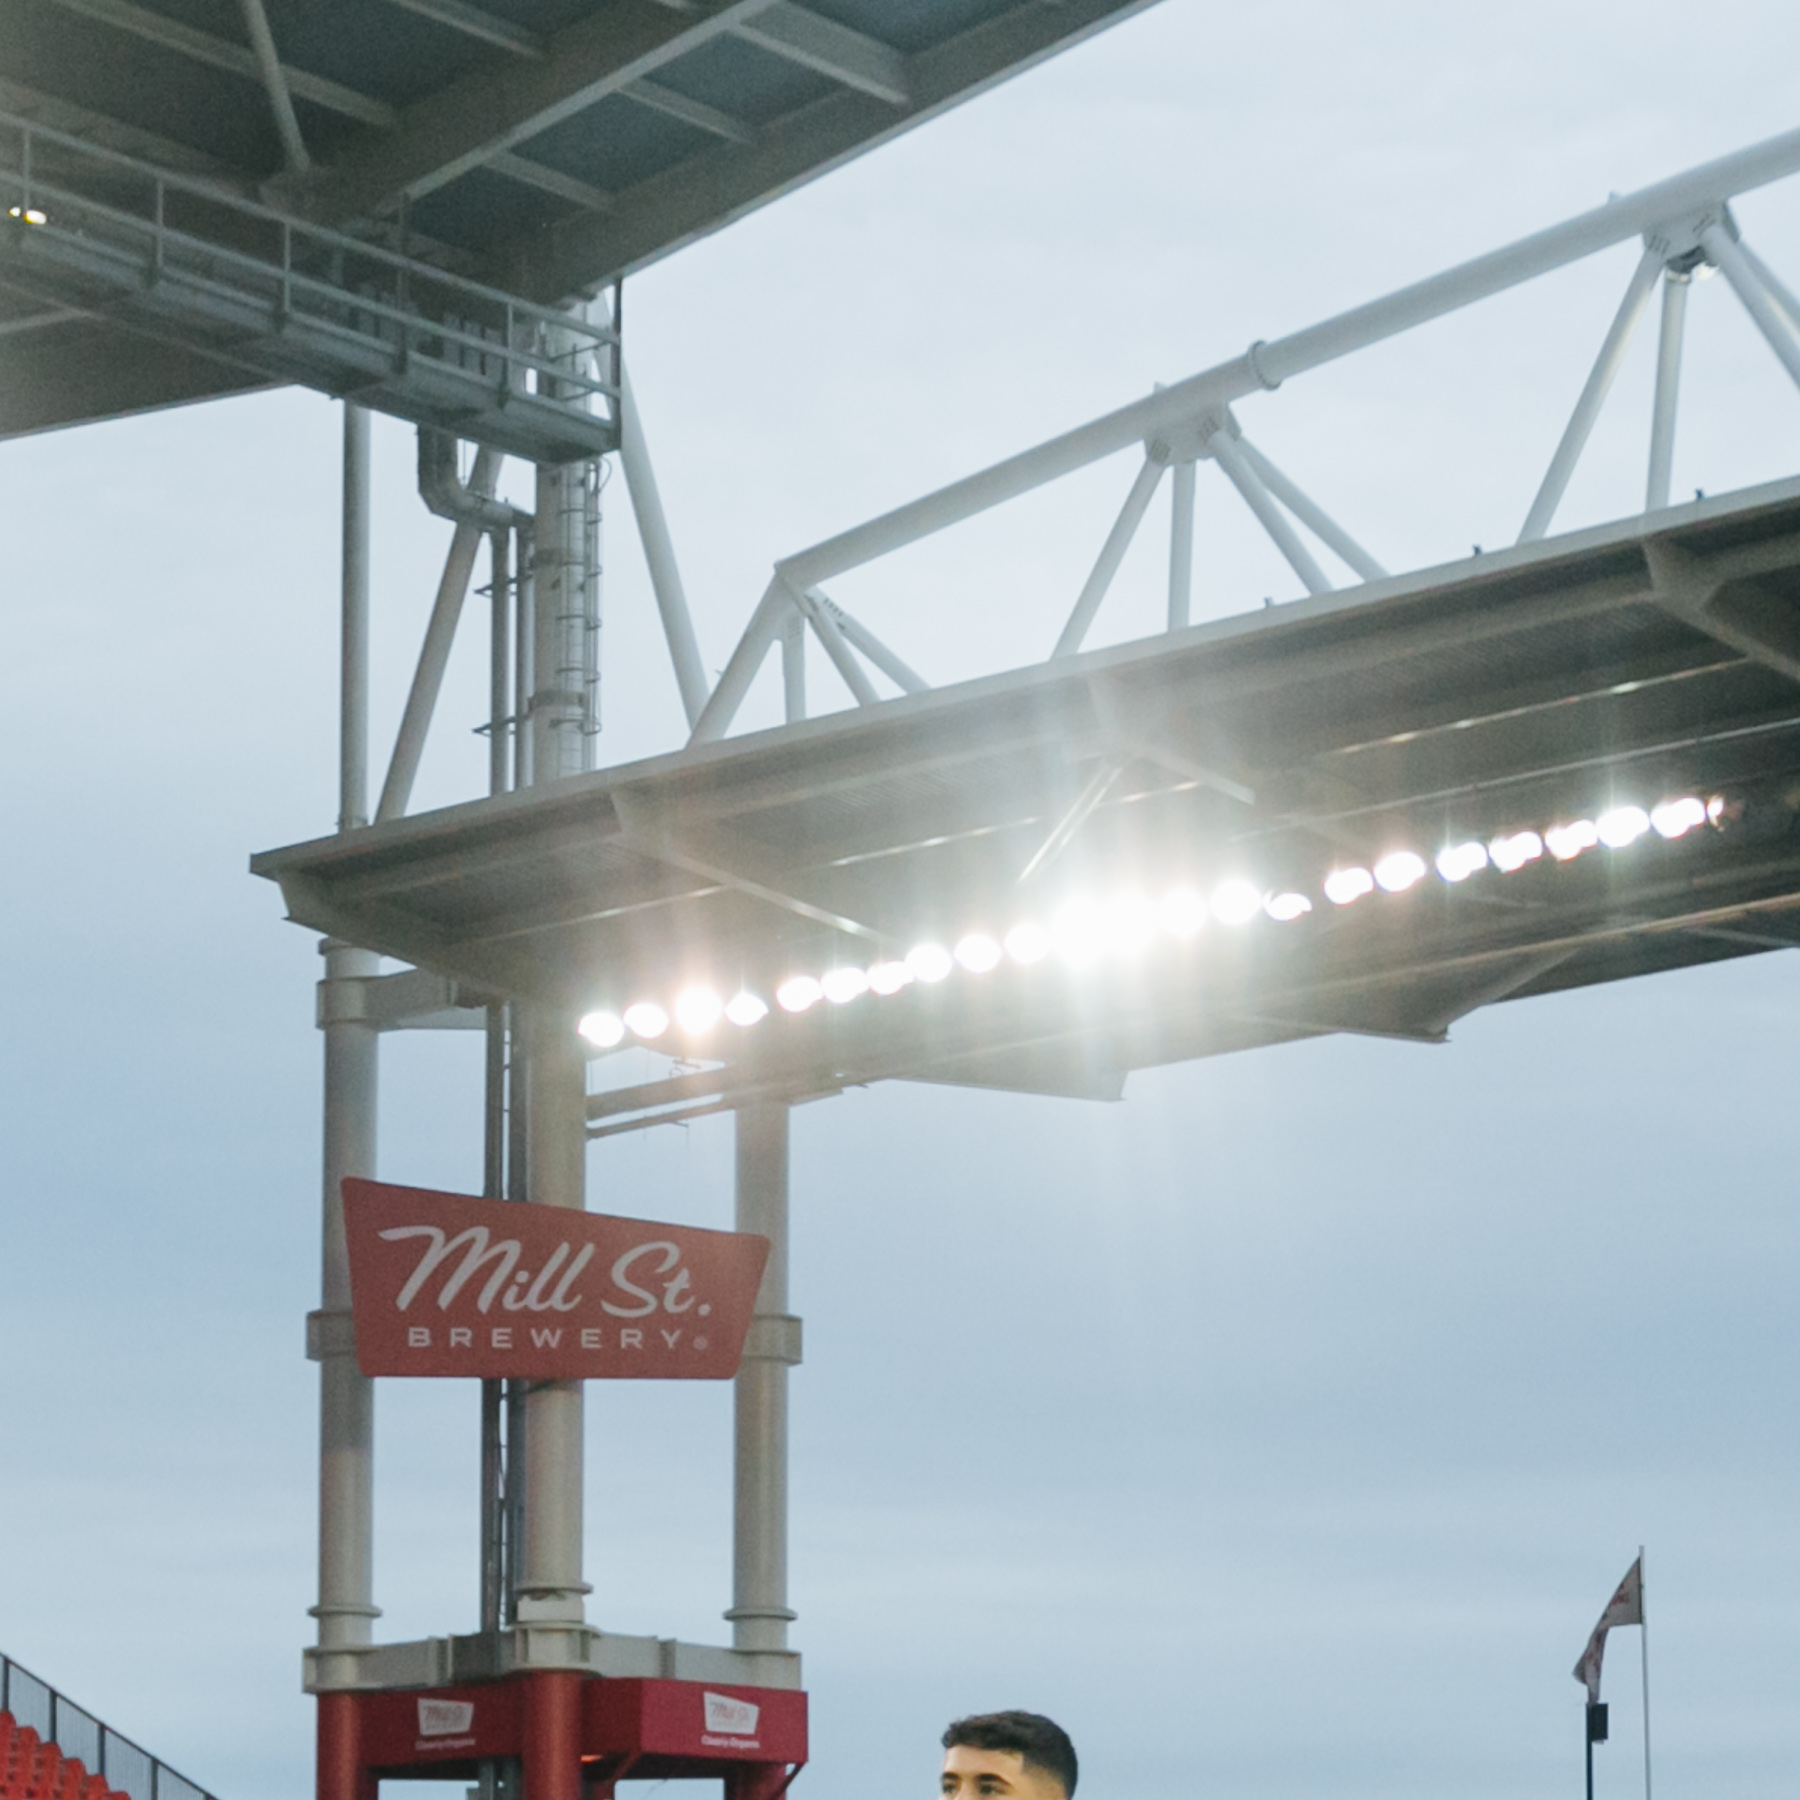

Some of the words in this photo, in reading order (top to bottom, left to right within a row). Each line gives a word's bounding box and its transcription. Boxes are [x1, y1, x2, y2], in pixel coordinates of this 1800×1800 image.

[378, 1225, 595, 1314] Mill
[601, 1241, 711, 1318] St.
[407, 1327, 682, 1349] BREWERY
